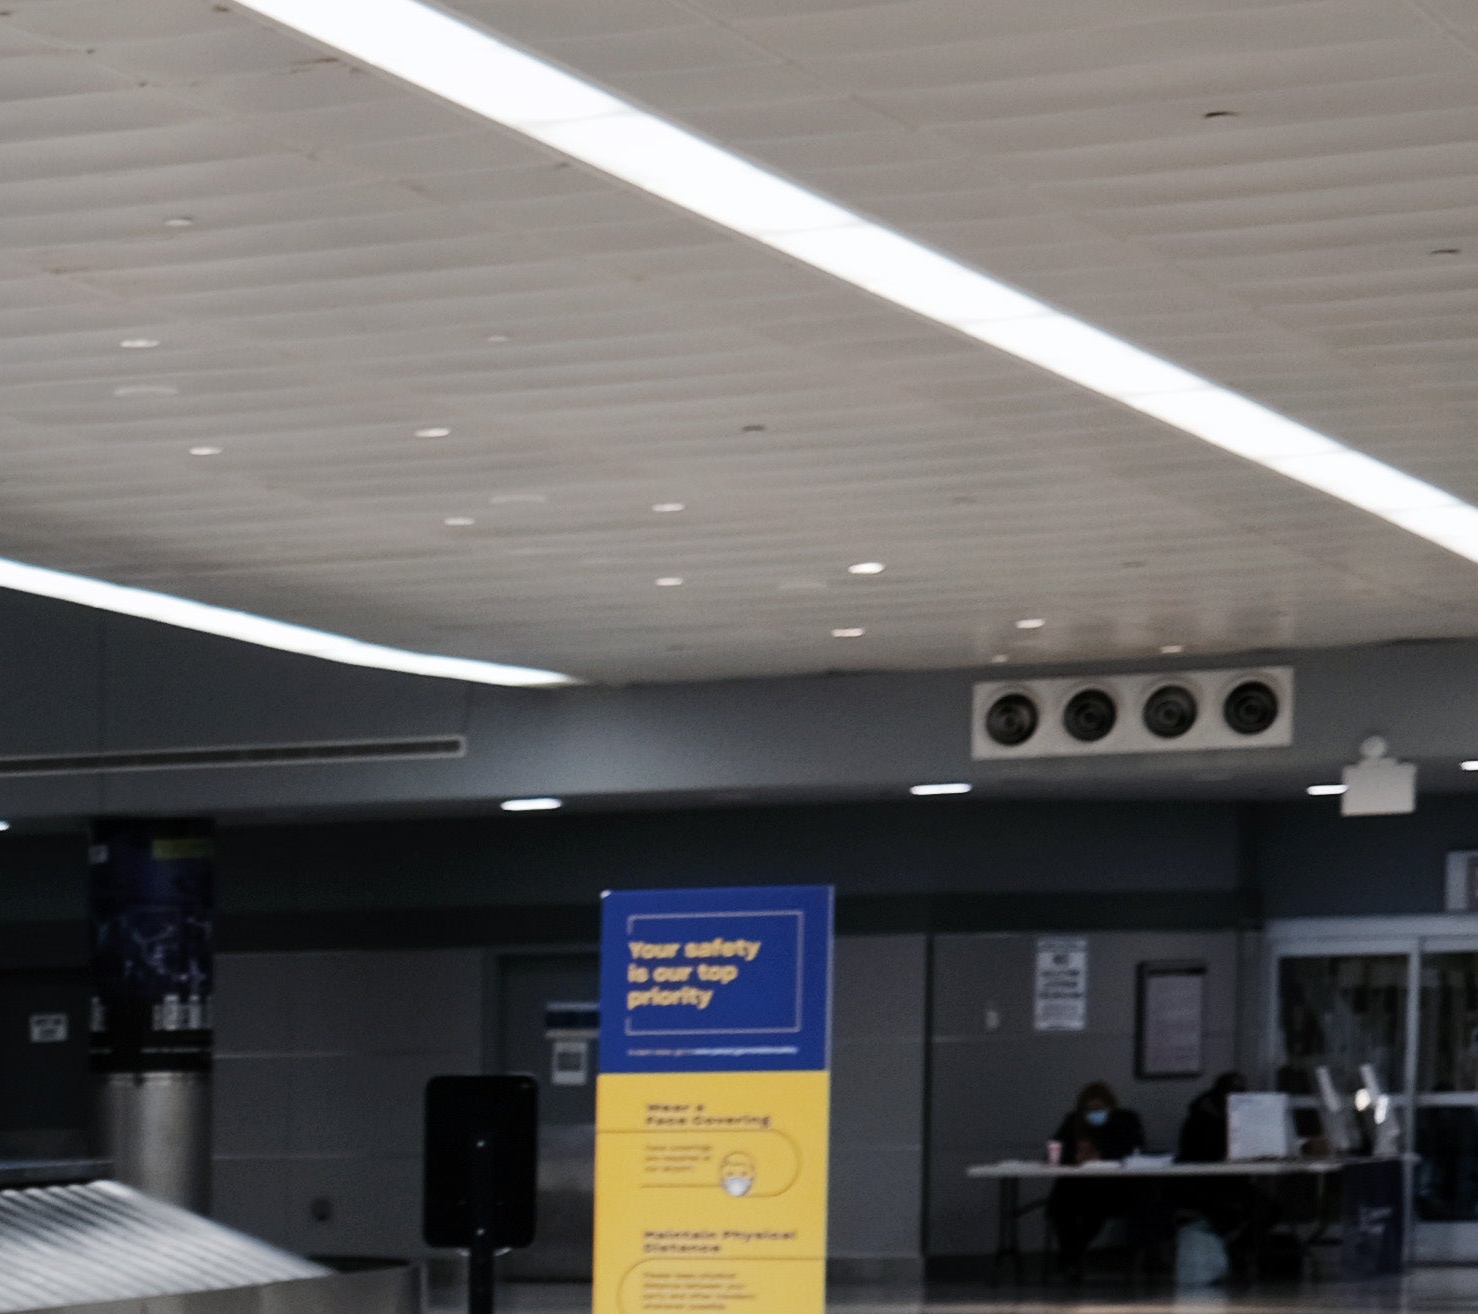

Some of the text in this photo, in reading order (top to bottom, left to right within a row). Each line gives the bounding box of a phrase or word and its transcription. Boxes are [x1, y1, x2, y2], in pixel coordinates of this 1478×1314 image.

[628, 937, 761, 961] Your safety
[627, 963, 738, 984] is our top
[627, 985, 714, 1010] priority
[691, 1115, 772, 1128] Covering
